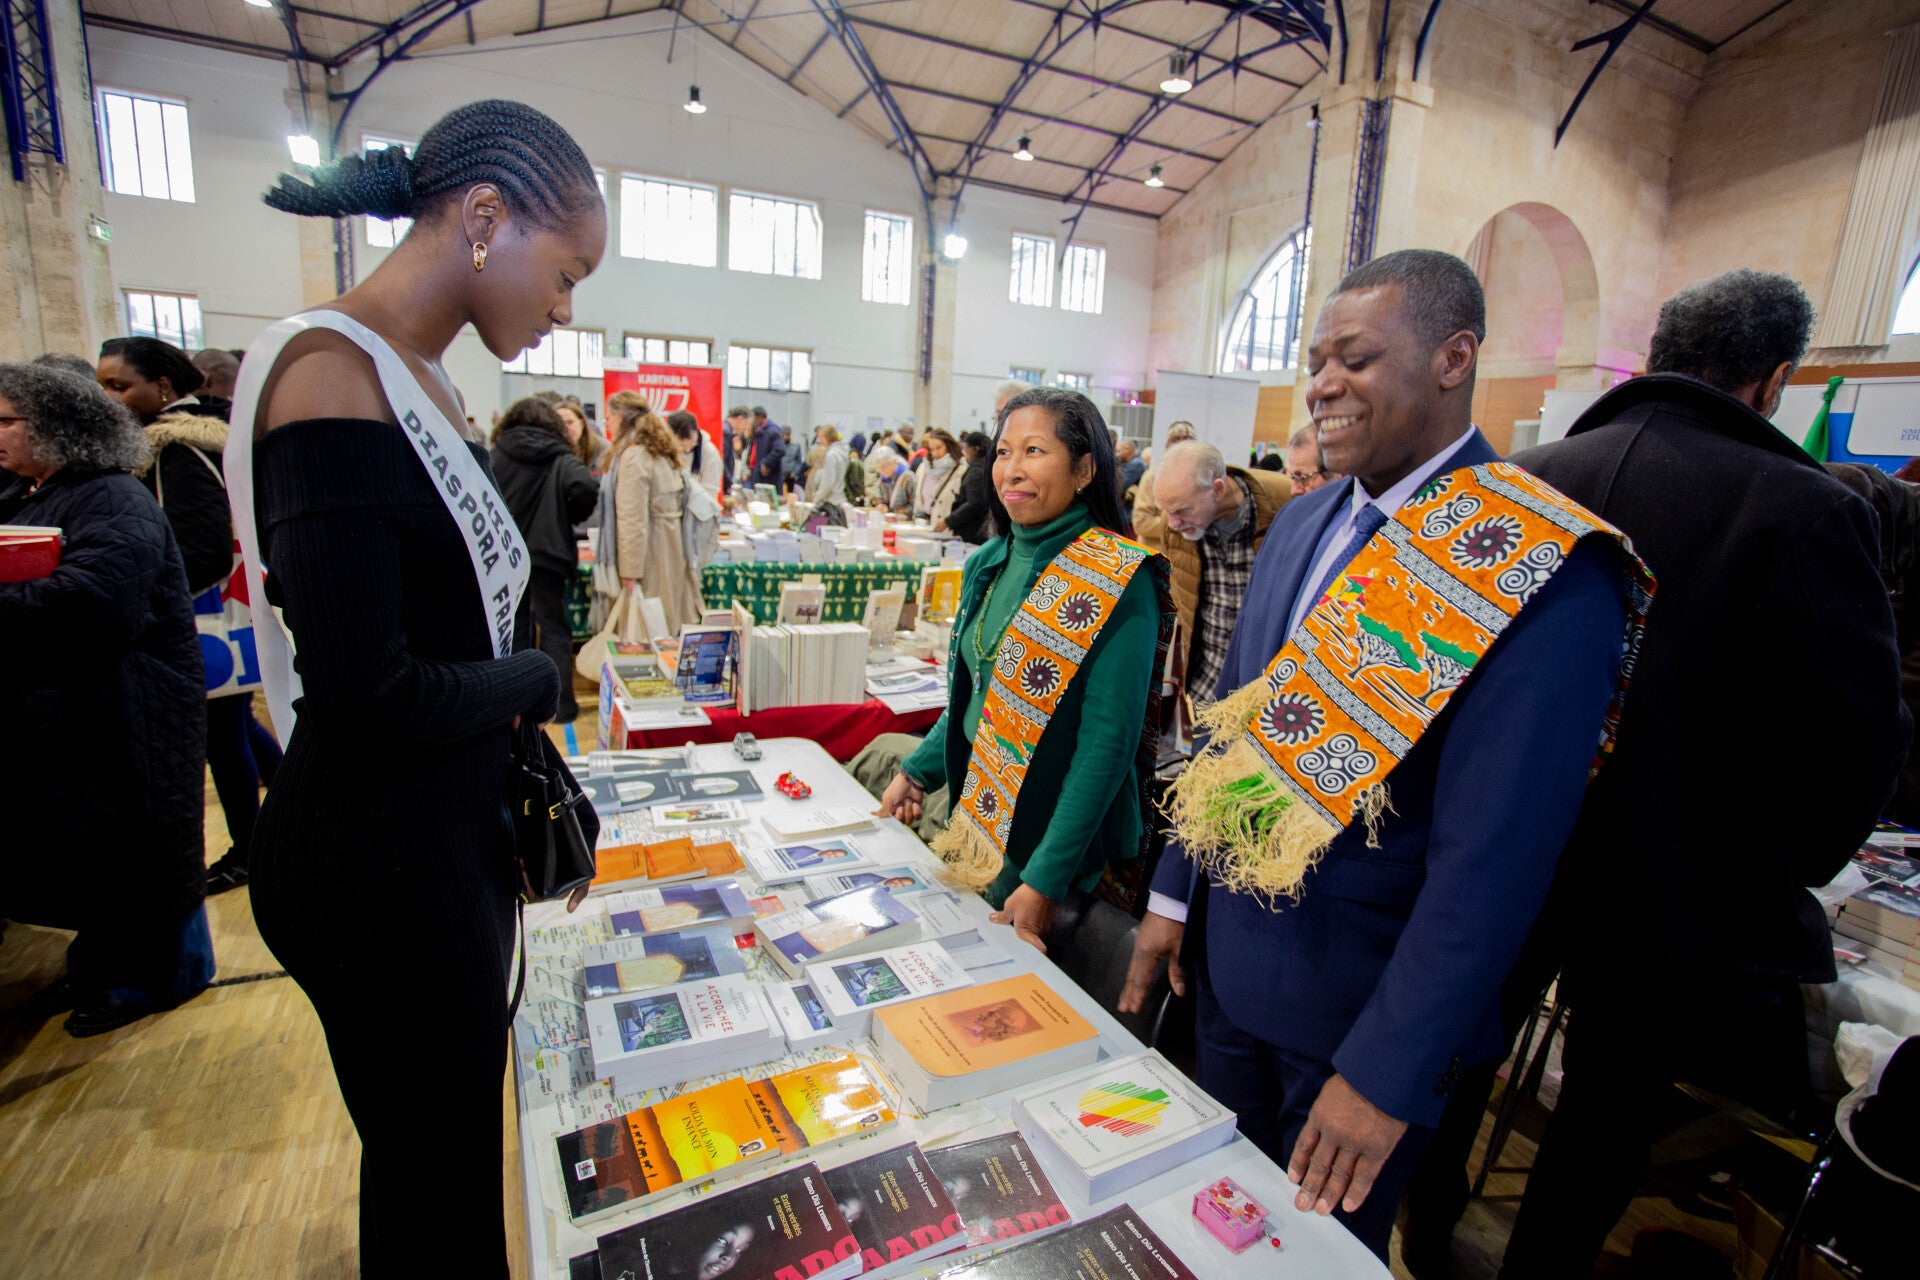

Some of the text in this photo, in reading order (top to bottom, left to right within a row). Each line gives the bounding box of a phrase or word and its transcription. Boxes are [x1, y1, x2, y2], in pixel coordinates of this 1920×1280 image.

[638, 373, 690, 387] KARTHALA
[402, 408, 500, 577] DIASPORA
[904, 962, 916, 974] LA
[913, 973, 927, 987] VIE
[908, 948, 944, 989] ACCROCHÉE
[696, 1000, 708, 1012] LA
[701, 1013, 715, 1030] VIE
[705, 983, 734, 1033] ACCROCHÉE
[680, 1116, 702, 1151] ENFANCE
[687, 1101, 704, 1127] KOLDA
[702, 1136, 718, 1159] MON
[906, 1154, 919, 1172] Mimo
[914, 1171, 925, 1183] Dia
[990, 1155, 1005, 1174] Entre
[1009, 1143, 1023, 1161] Mimo
[802, 1175, 817, 1195] Mimo
[810, 1193, 822, 1206] Dia
[881, 1179, 901, 1213] mensonges
[885, 1169, 909, 1210] Entre vérités
[985, 1163, 1008, 1196] mensonges
[771, 1204, 796, 1240] mensonges
[779, 1193, 804, 1236] Entre vérités
[1124, 1219, 1143, 1239] Mimo
[1141, 1237, 1153, 1251] Dia
[1083, 1248, 1100, 1269] Entre
[1100, 1231, 1141, 1280] Mimo Dia LEYD
